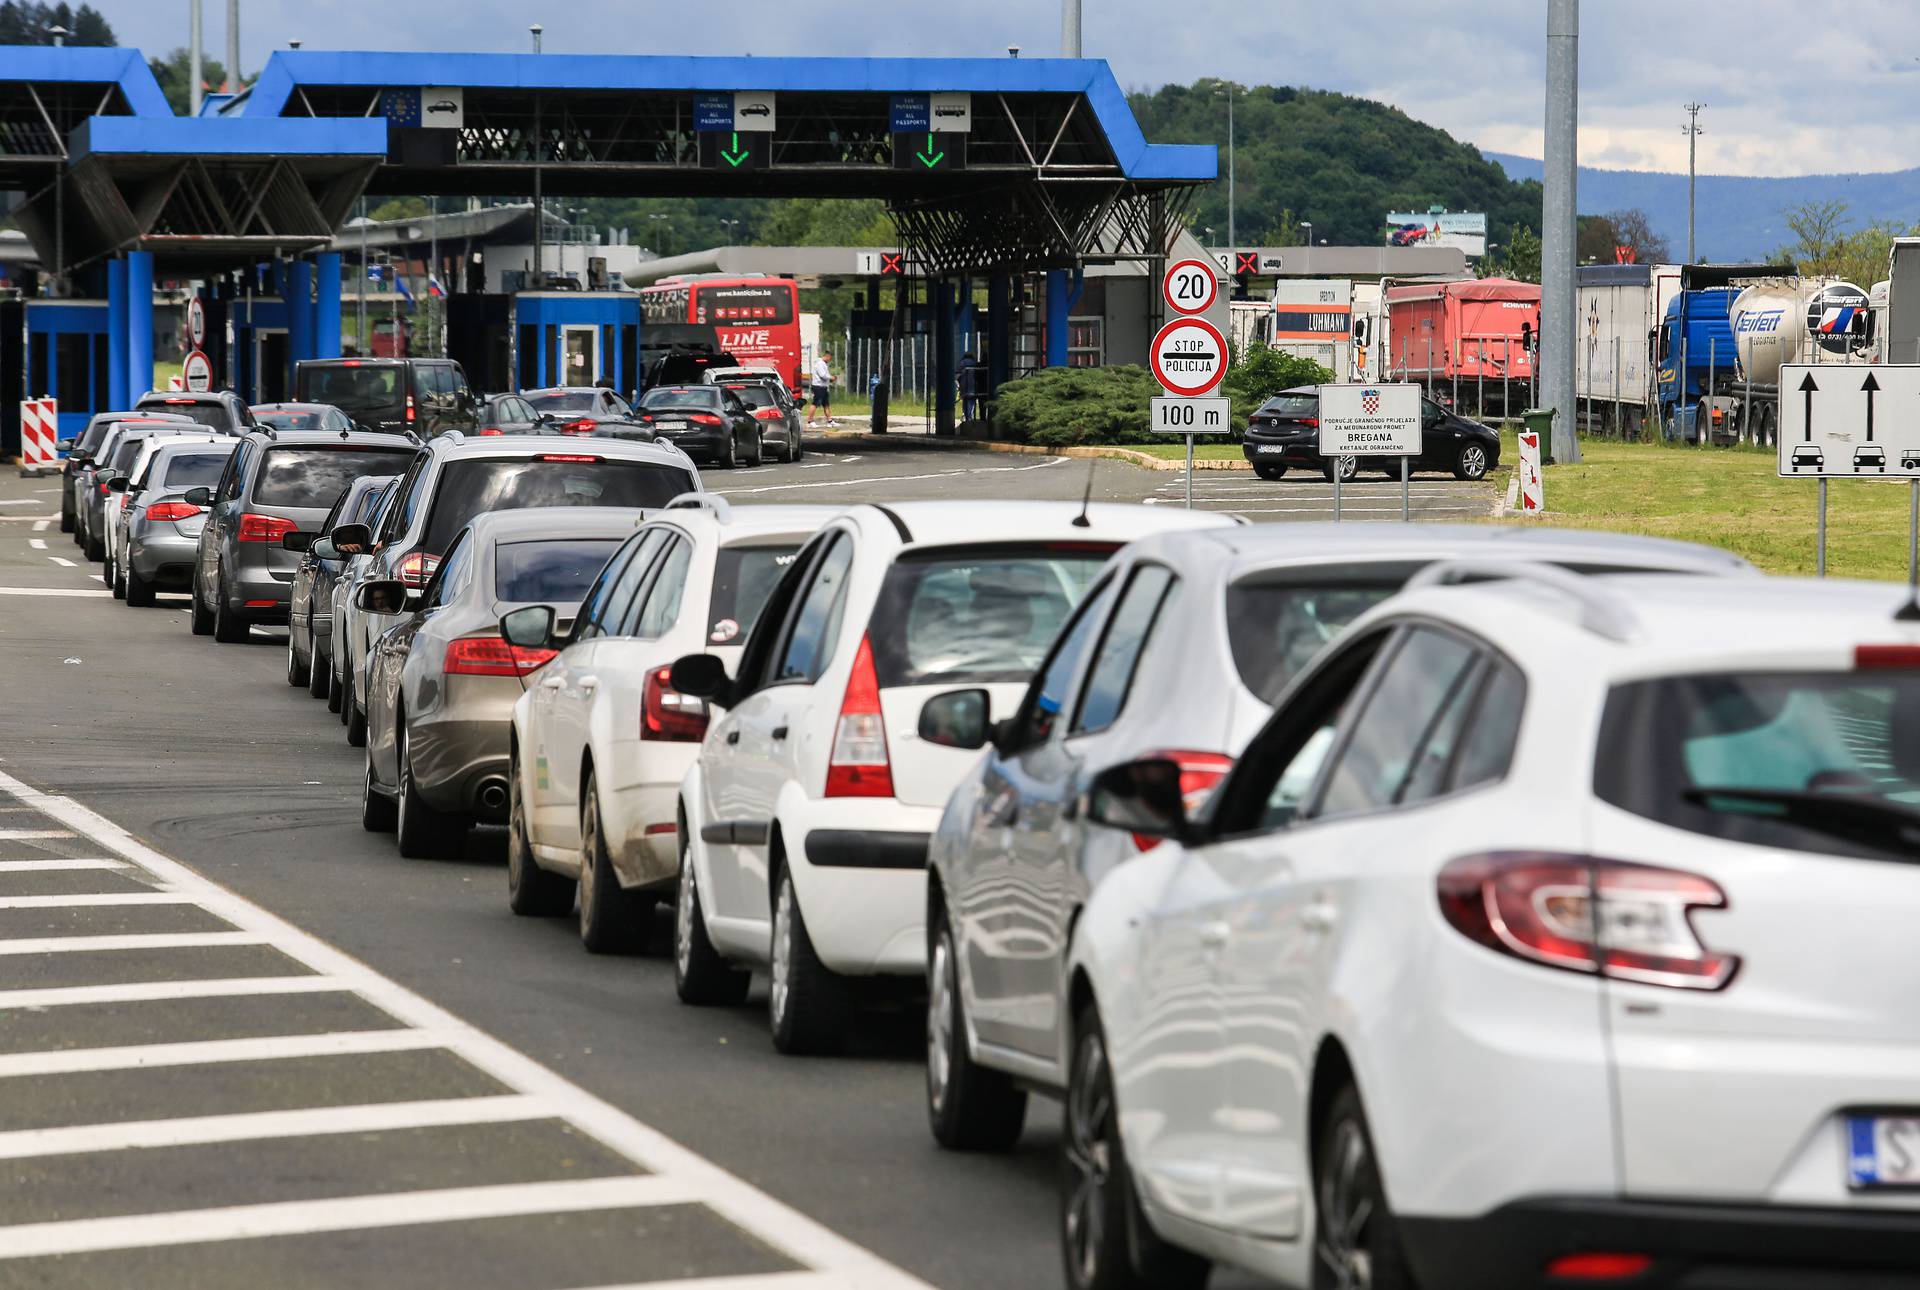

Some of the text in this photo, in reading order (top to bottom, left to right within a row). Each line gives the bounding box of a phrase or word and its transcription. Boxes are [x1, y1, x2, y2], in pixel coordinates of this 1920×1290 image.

[866, 256, 871, 271] 1
[1220, 255, 1228, 271] 3
[1177, 274, 1204, 299] 20
[721, 333, 769, 346] LINE
[1174, 340, 1204, 352] STOP
[1165, 360, 1212, 372] POLICIJA
[1162, 405, 1219, 425] 100 m
[1347, 433, 1393, 442] BREGANA
